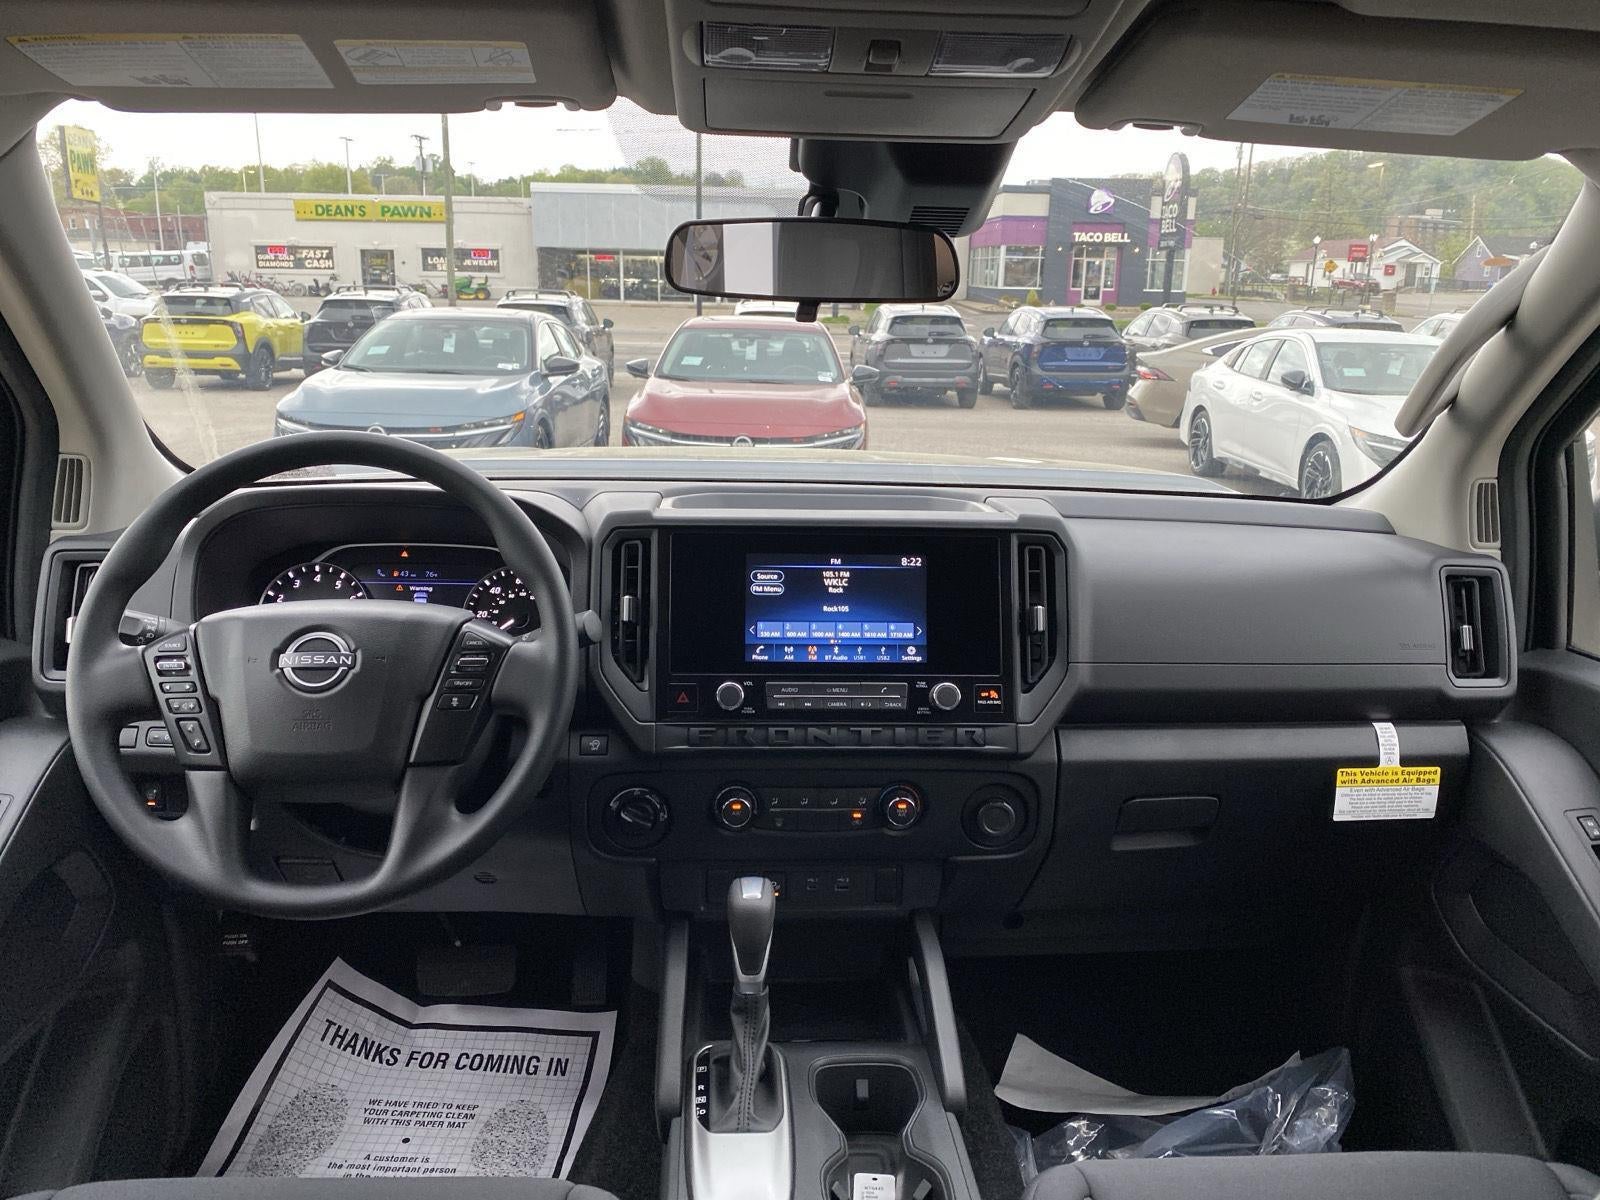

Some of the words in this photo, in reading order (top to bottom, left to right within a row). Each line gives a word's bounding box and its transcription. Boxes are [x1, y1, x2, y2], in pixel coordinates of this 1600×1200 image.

[315, 203, 366, 217] DEAN'S
[380, 205, 432, 218] PAWN
[1162, 203, 1178, 219] TACO
[1161, 218, 1177, 233] BELL
[1073, 232, 1103, 242] TACO
[1104, 233, 1131, 242] BELL
[302, 249, 329, 259] FAST
[304, 259, 333, 268] CASH
[901, 557, 922, 566] 8:22
[314, 574, 321, 582] 4
[824, 578, 849, 586] WKLC
[293, 580, 300, 588] 3
[335, 581, 342, 589] 5
[276, 595, 284, 603] 2
[281, 655, 352, 665] NISSAN
[689, 726, 985, 746] FRONTIER
[1401, 769, 1438, 778] Equipped
[320, 1018, 402, 1067] THANKS
[405, 1051, 450, 1070] FOR
[454, 1052, 541, 1076] COMING
[546, 1057, 569, 1076] IN
[368, 1098, 383, 1107] WE
[384, 1099, 409, 1108] HAVE
[412, 1101, 439, 1109] TRIED
[455, 1103, 479, 1111] KEEP
[363, 1107, 389, 1116] YOUR
[391, 1109, 443, 1119] CARPETING
[445, 1111, 476, 1120] CLEAN
[363, 1117, 388, 1125] WITH
[391, 1118, 411, 1127] THIS
[414, 1120, 444, 1128] PAPER
[446, 1121, 468, 1129] MAT
[364, 1153, 371, 1161] A
[373, 1154, 418, 1163] customer
[327, 1161, 343, 1170] the
[346, 1162, 371, 1171] most
[373, 1163, 421, 1174] important
[422, 1167, 456, 1175] person
